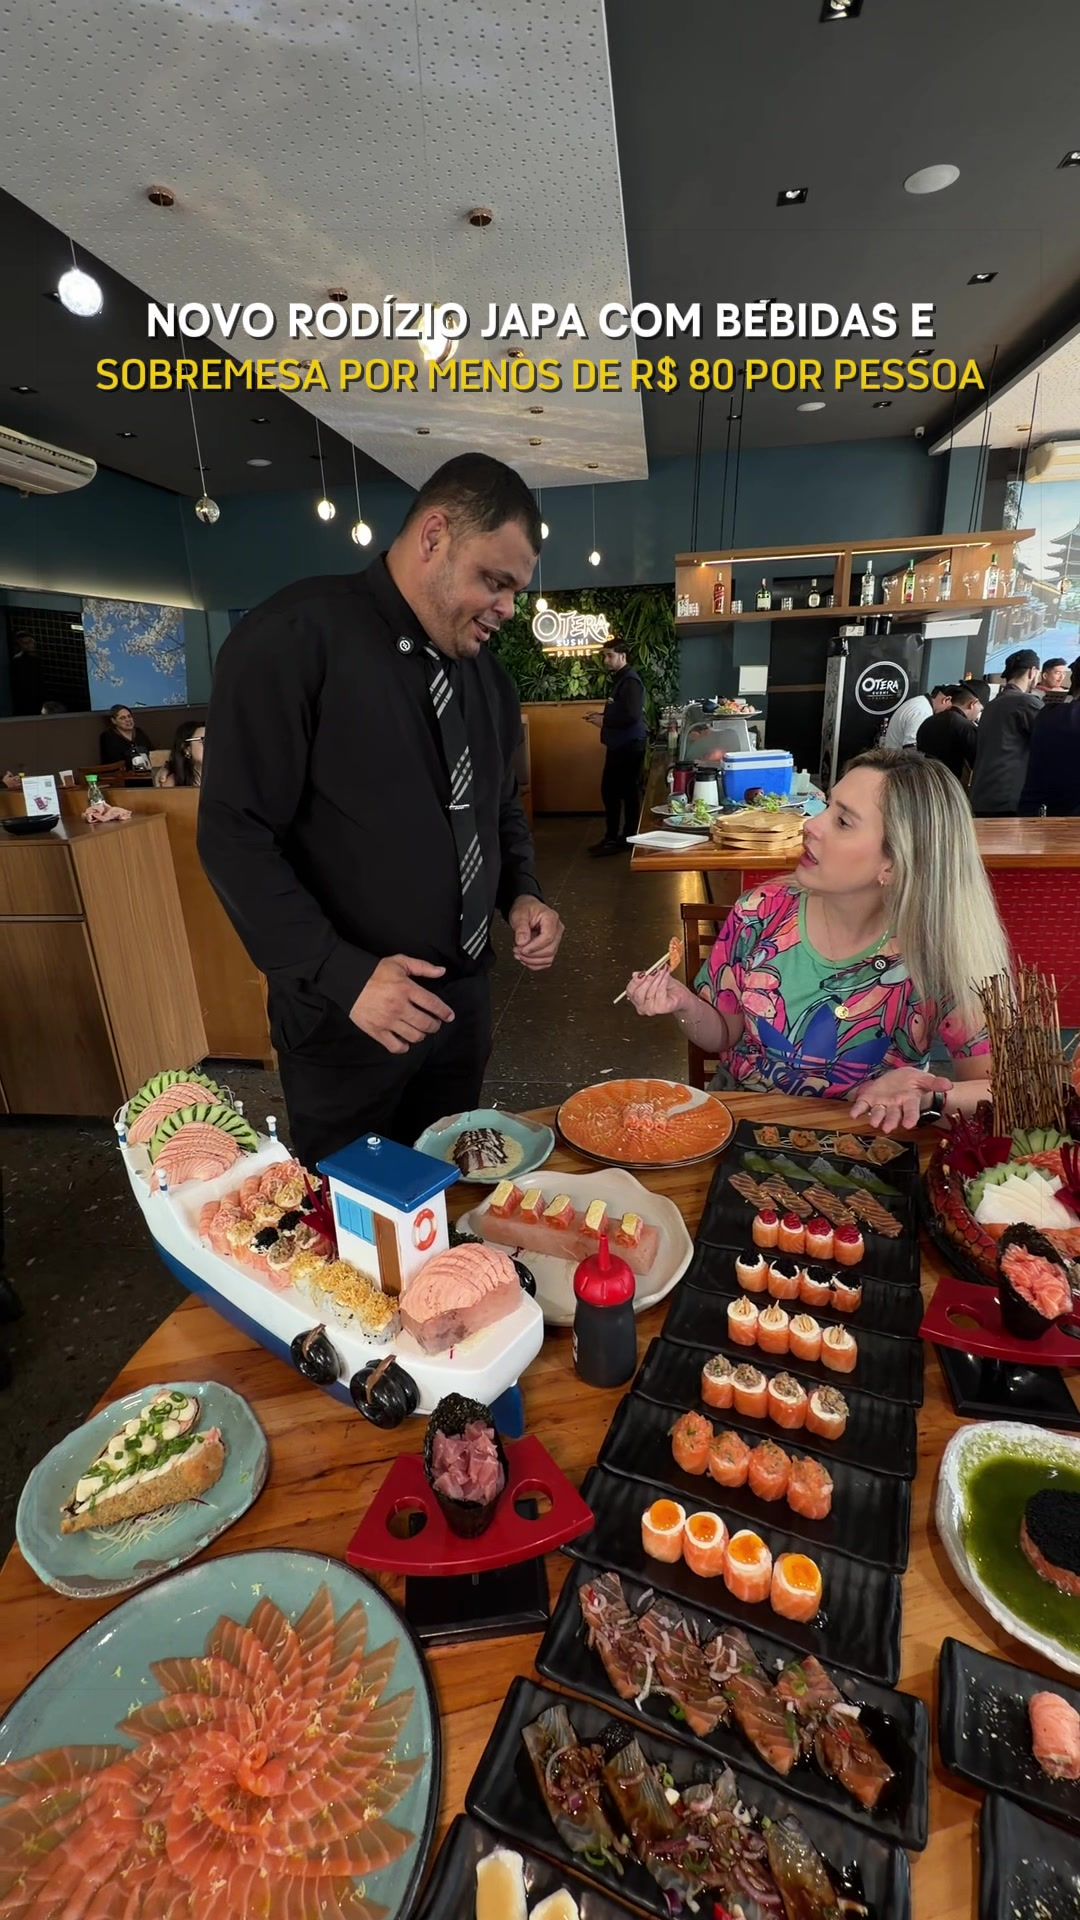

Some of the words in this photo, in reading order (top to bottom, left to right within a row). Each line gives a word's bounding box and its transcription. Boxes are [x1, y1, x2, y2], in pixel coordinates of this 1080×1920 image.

[532, 609, 611, 644] OTERA
[556, 638, 589, 647] SUSHI
[862, 677, 899, 694] OTERA
